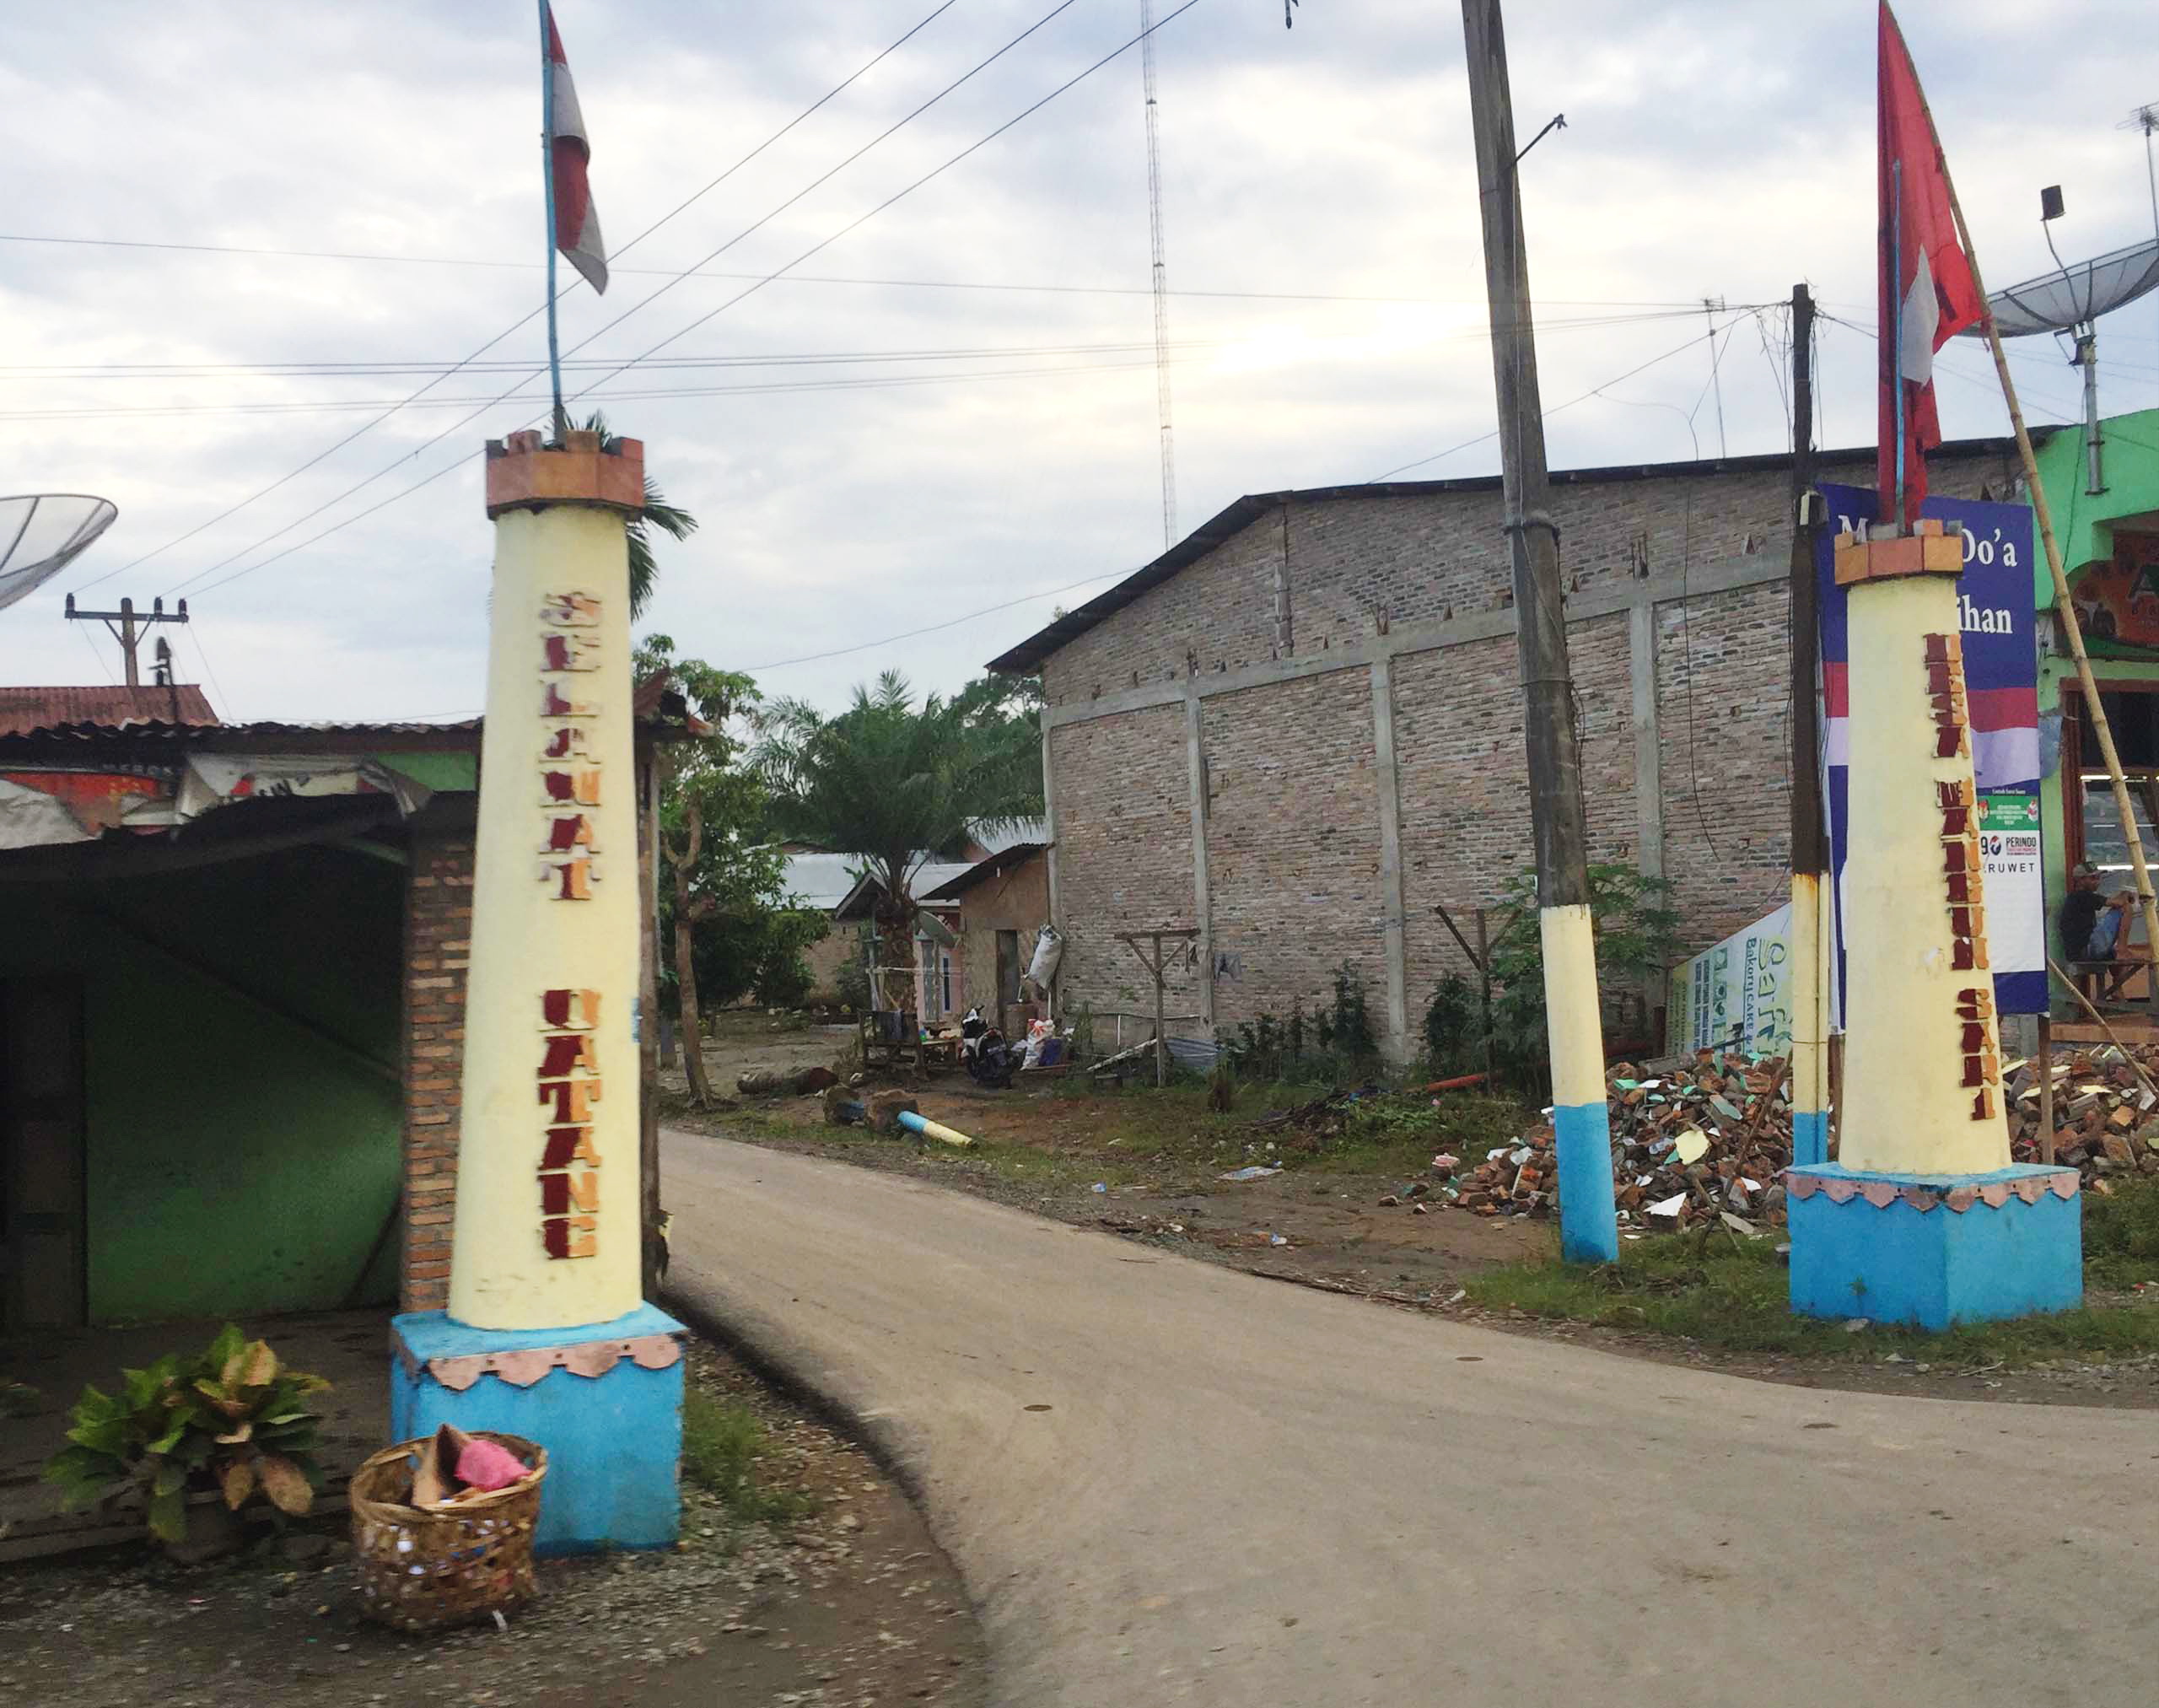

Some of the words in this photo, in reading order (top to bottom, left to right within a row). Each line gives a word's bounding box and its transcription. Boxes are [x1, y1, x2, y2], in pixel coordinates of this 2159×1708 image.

[1957, 594, 2013, 633] ihan
[537, 591, 601, 900] SELAMAT
[2006, 836, 2037, 849] PERINDO
[1954, 989, 1999, 1120] SARI
[537, 989, 601, 1260] DATANG
